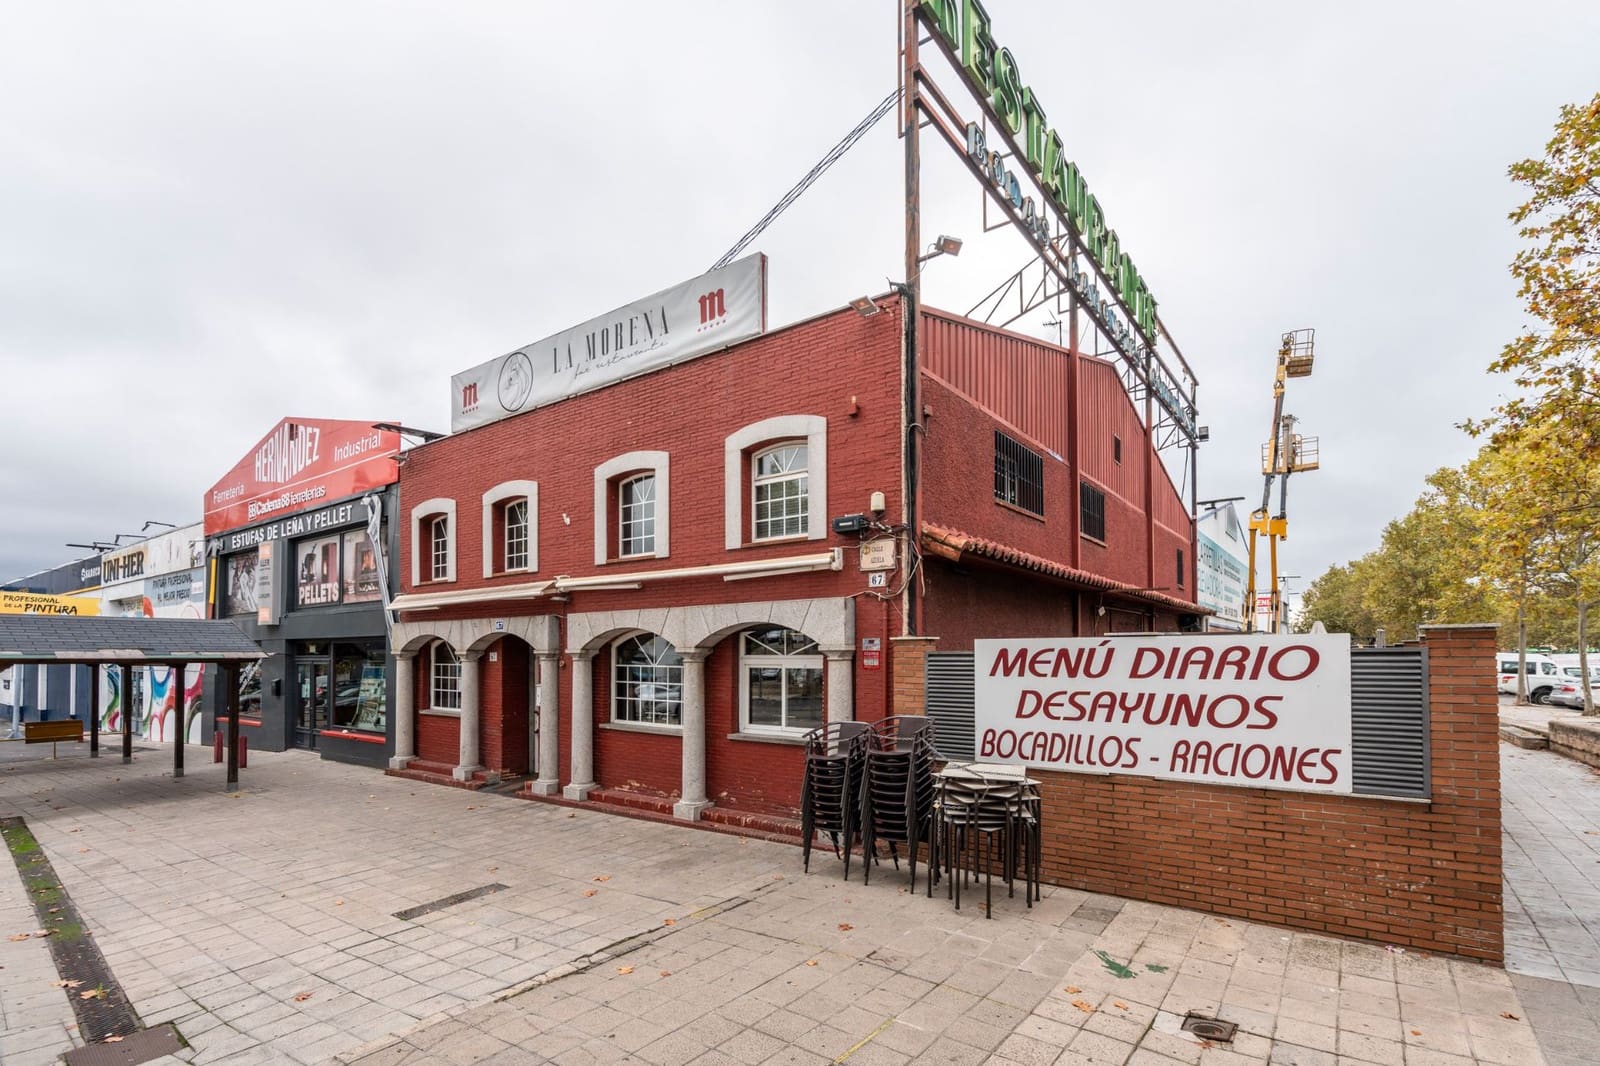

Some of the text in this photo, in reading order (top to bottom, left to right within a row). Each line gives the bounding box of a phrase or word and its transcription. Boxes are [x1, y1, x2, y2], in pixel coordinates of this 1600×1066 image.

[553, 304, 670, 375] LA MORENA
[334, 430, 382, 463] Industrial
[231, 505, 353, 549] ESTUFAS DE LEÑA Y PELLET
[103, 551, 144, 583] UNI-HER
[871, 574, 883, 585] 67
[3, 594, 60, 604] PROFESIONAL
[24, 603, 77, 615] PINTURA
[298, 582, 339, 606] PELLETS
[989, 639, 1321, 682] MENÚ DIARIO
[1015, 688, 1284, 731] DESAYUNOS
[979, 728, 1142, 769] BOCADILLOS
[1169, 739, 1342, 785] RACIONES
